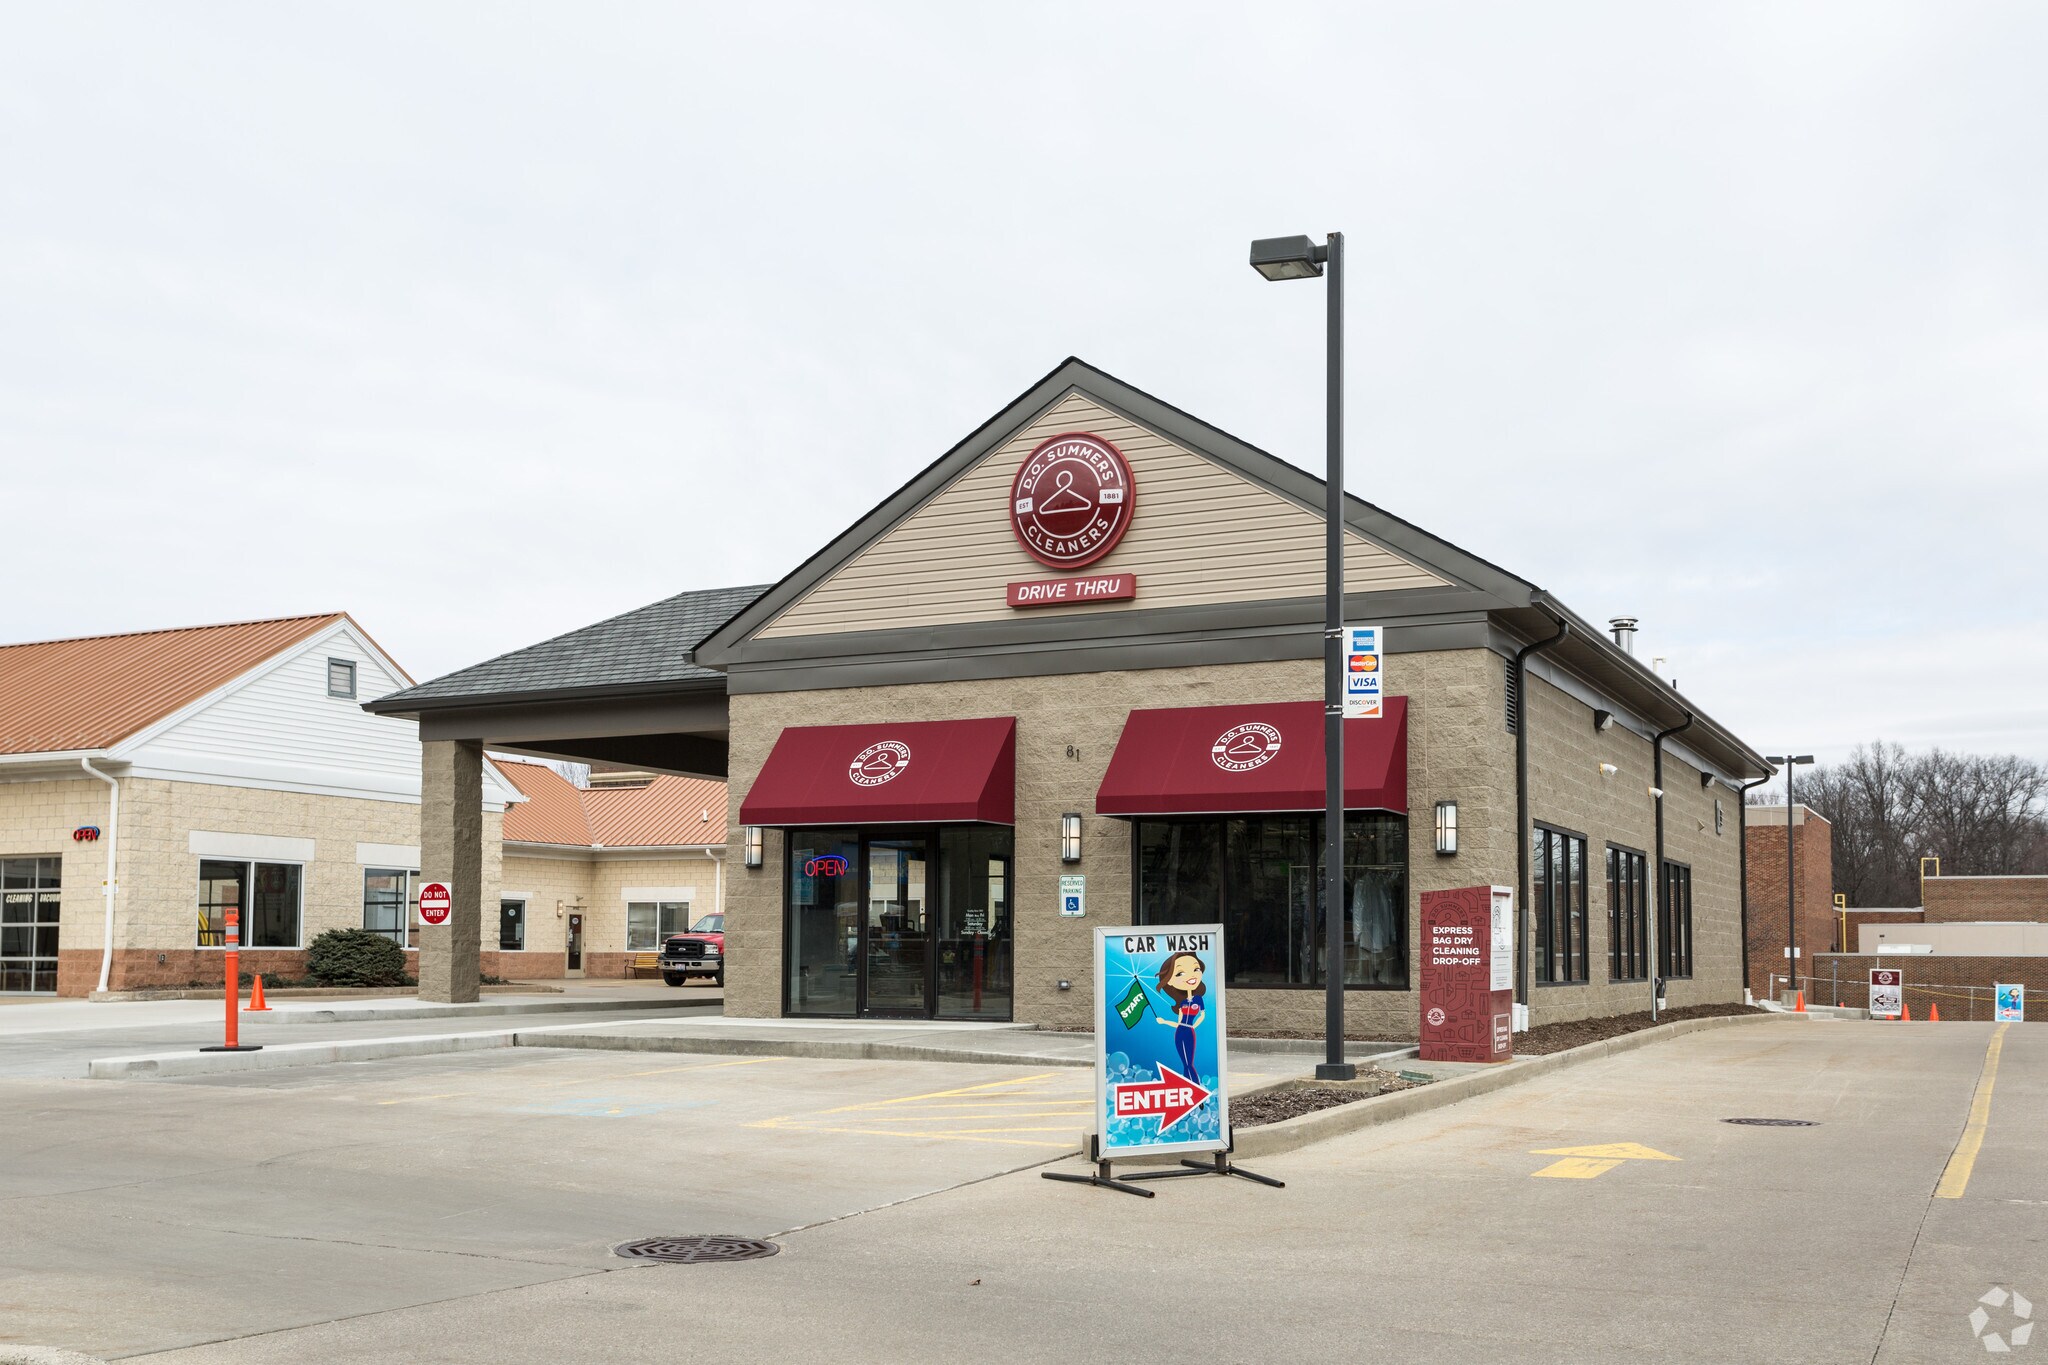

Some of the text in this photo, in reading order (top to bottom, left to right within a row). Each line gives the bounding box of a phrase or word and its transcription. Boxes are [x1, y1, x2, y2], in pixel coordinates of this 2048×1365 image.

[1023, 445, 1114, 490] D.O. SUMMERS
[1103, 492, 1120, 500] 1881
[1019, 501, 1030, 510] EST
[1028, 518, 1109, 554] CLEANERS
[1017, 579, 1121, 601] DRIVE THRU
[1352, 677, 1377, 687] VISA
[1240, 725, 1278, 741] SUMMERS
[877, 743, 907, 758] SUMMERS
[1066, 745, 1080, 762] 81
[1217, 756, 1268, 770] CLEANERS
[853, 772, 896, 784] CLEANERS
[73, 829, 97, 841] OPEN
[805, 859, 845, 877] OPEN
[6, 893, 33, 903] CLEANING
[426, 909, 444, 917] ENTER
[1124, 935, 1209, 953] CAR WASH
[1433, 947, 1479, 955] CLEANING
[1433, 957, 1480, 965] DROP-OFF
[1120, 993, 1144, 1018] START
[1118, 1087, 1195, 1111] ENTER
